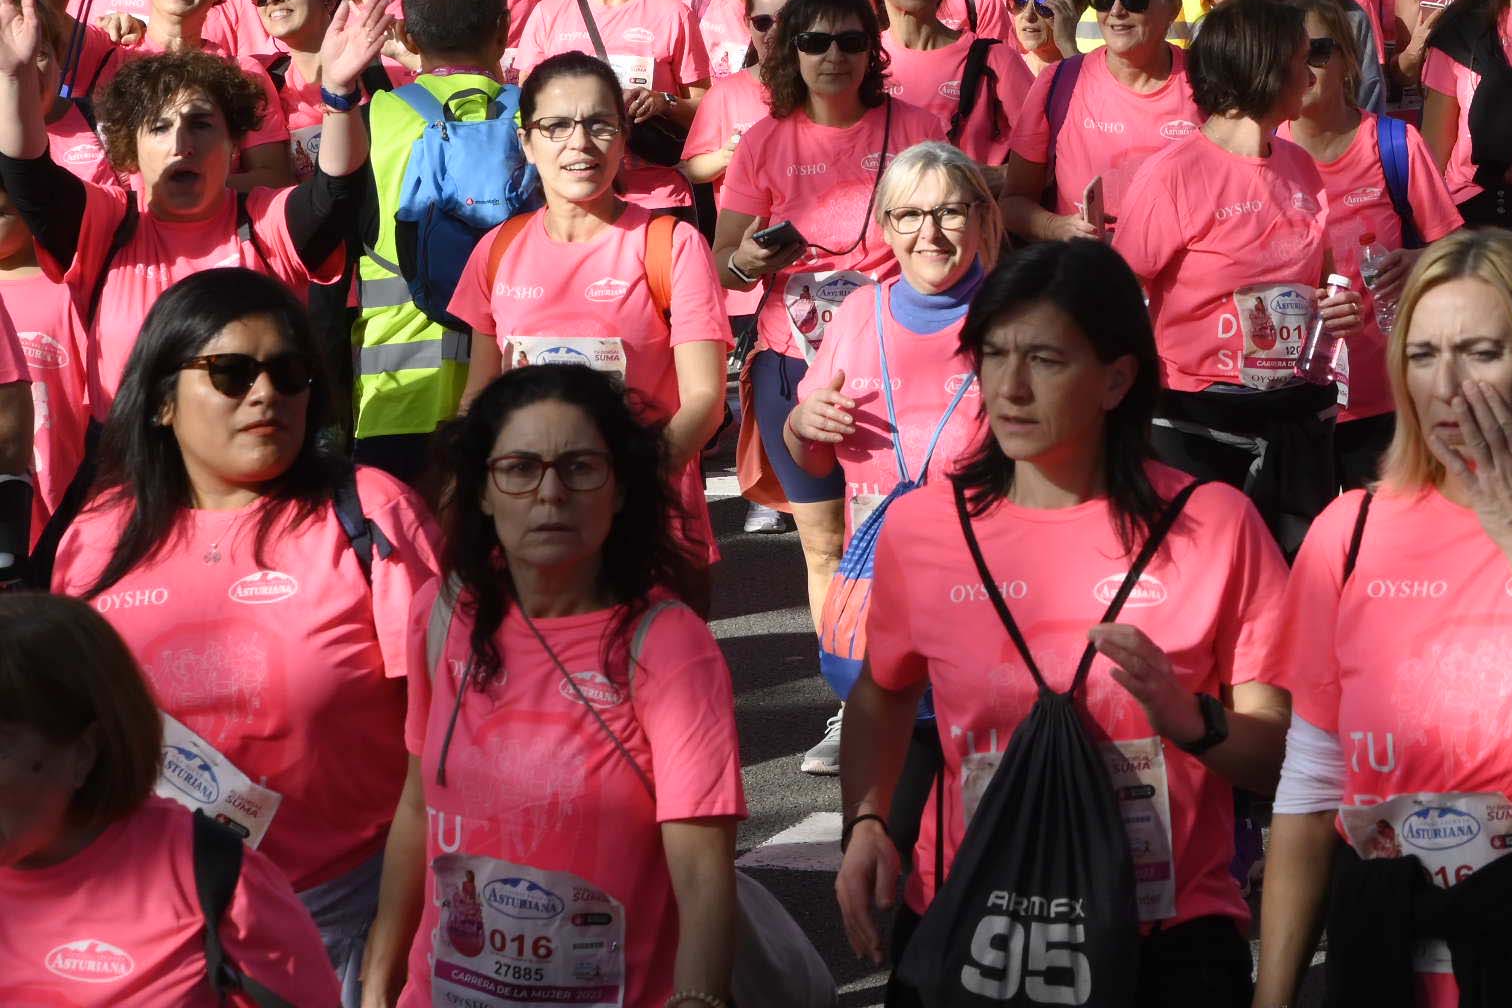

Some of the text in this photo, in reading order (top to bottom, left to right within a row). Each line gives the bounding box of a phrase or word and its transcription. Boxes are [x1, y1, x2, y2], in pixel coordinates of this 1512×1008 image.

[1216, 199, 1263, 221] OYSHO
[594, 354, 620, 362] SUMA
[97, 587, 169, 613] OYSHO
[236, 585, 293, 598] ASTURIANA
[1367, 579, 1449, 599] OYSHO
[1350, 731, 1397, 773] TU
[224, 793, 259, 819] SUMA
[1405, 822, 1475, 841] ASTURIANA
[488, 888, 557, 914] ASTURIANA
[490, 928, 553, 961] 016
[52, 953, 126, 974] ASTURIANA
[961, 914, 1092, 1006] 95
[452, 968, 496, 992] CARRERA
[496, 984, 512, 997] DE
[512, 987, 529, 999] LA
